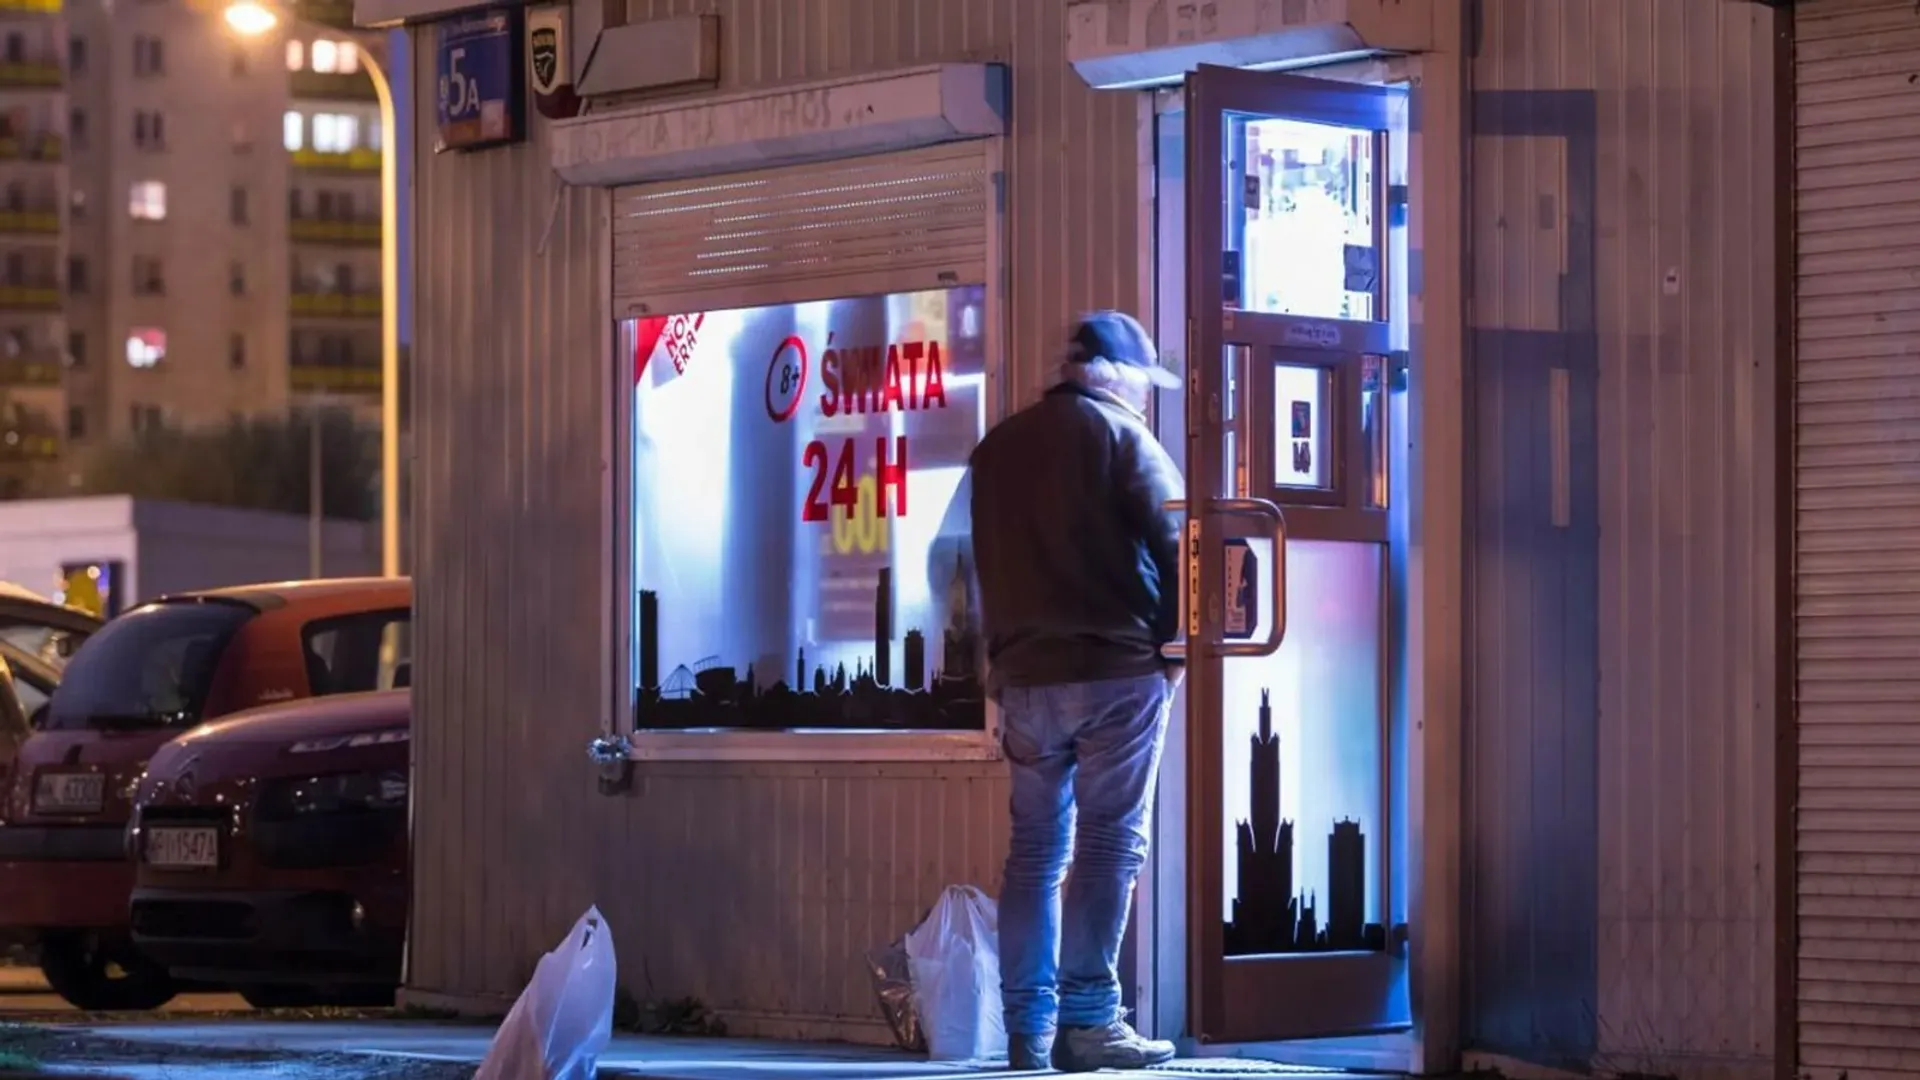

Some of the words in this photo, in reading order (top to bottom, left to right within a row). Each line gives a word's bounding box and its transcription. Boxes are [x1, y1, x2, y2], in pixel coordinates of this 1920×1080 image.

[673, 329, 697, 376] ERA
[820, 332, 947, 417] ŚWIATA
[803, 438, 857, 521] 24
[876, 436, 907, 517] H
